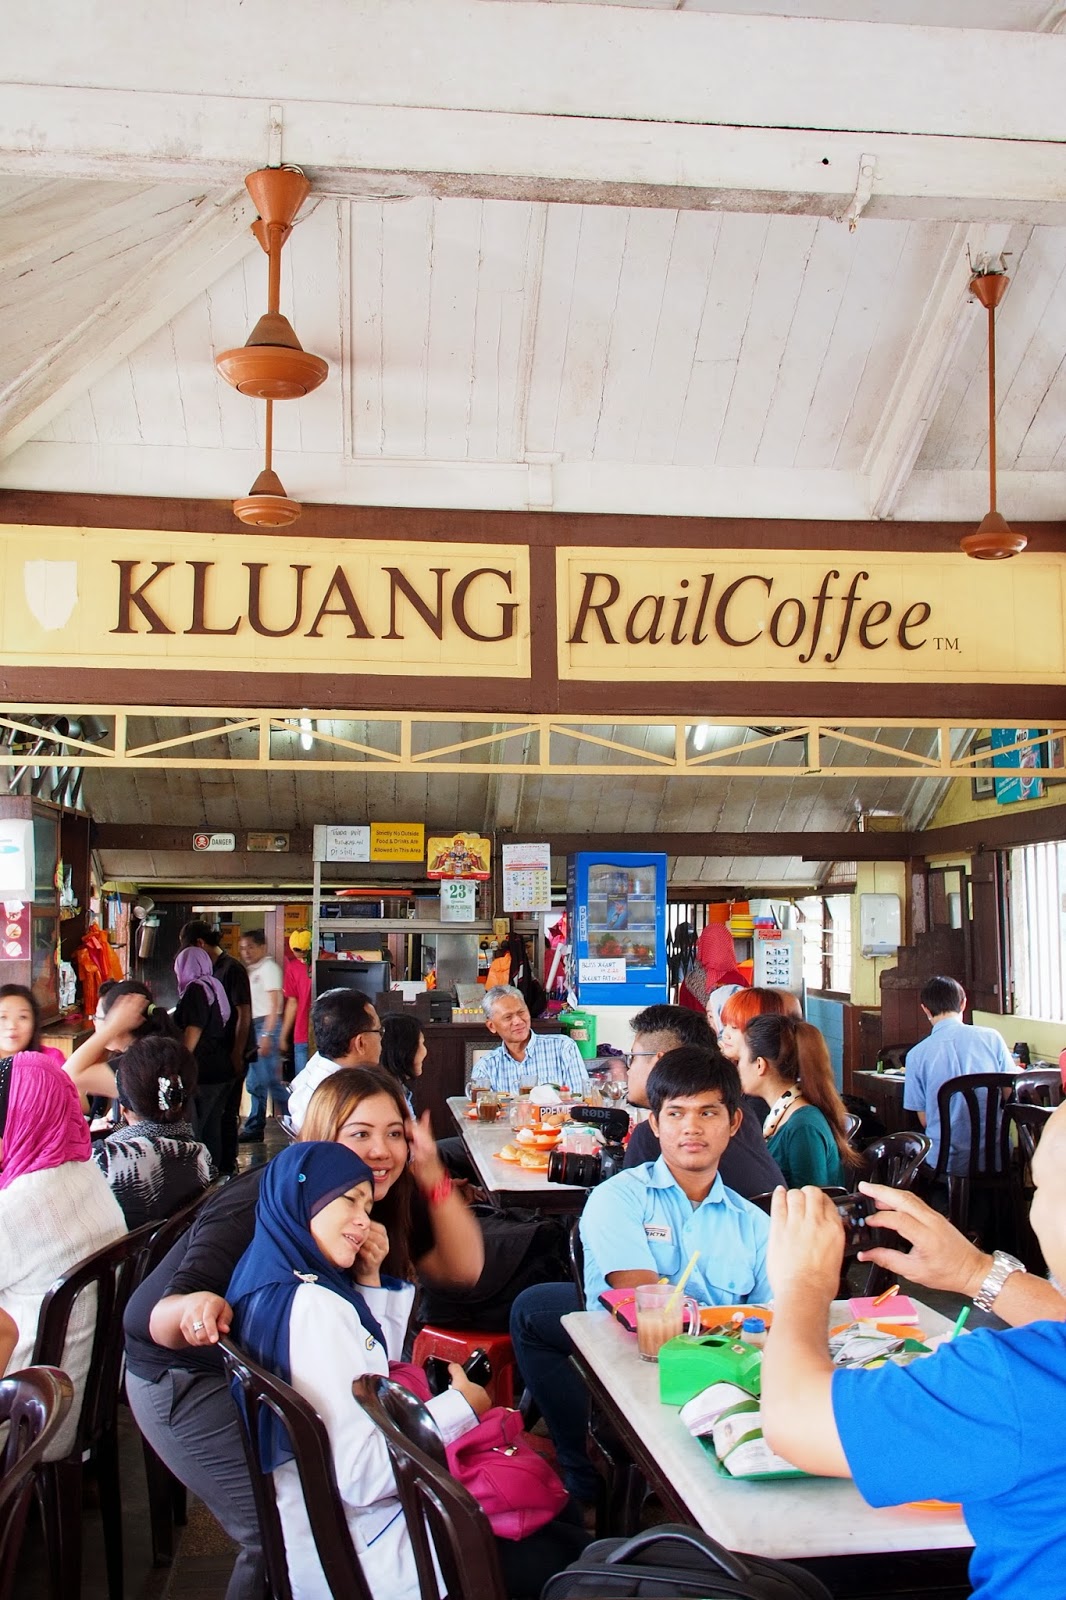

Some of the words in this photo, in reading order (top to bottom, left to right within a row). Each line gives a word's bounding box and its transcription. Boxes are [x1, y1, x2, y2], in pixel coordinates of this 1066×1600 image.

[108, 559, 520, 642] KLUANG
[565, 569, 932, 663] RailCoffee
[933, 637, 960, 651] TM
[211, 838, 233, 846] DANGER
[450, 884, 467, 899] 23
[540, 1106, 572, 1117] PREMIE
[582, 1108, 612, 1120] RØDE
